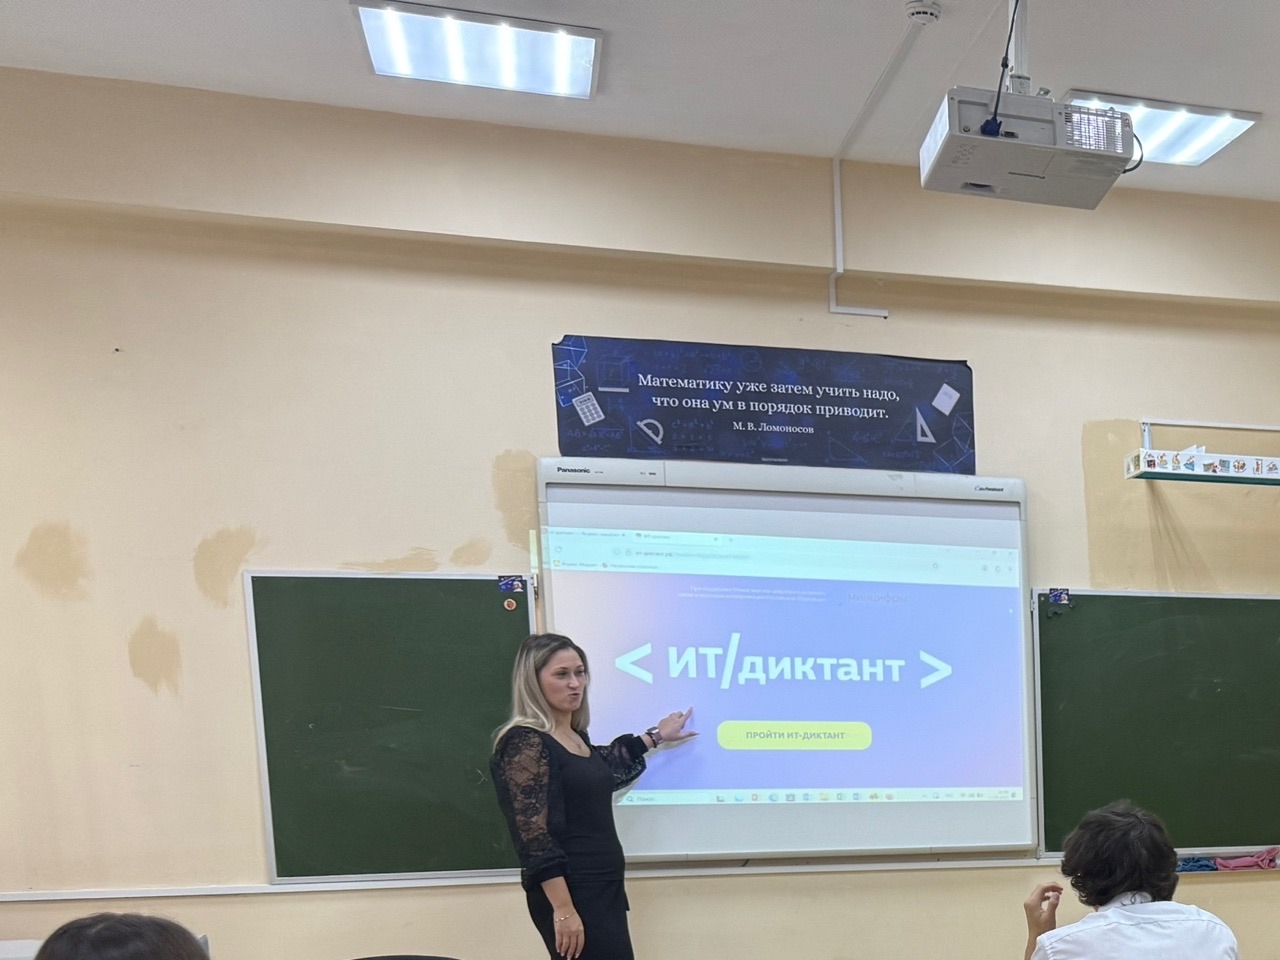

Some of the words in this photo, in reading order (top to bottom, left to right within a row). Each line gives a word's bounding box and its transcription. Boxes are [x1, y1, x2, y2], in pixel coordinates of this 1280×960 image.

[638, 373, 733, 394] Математику
[736, 381, 767, 394] уже
[770, 382, 813, 395] затем
[815, 385, 860, 399] учить
[863, 388, 900, 402] надо,
[652, 396, 679, 408] что
[682, 398, 710, 409] она
[712, 399, 734, 412] ум
[737, 400, 746, 411] в
[749, 400, 812, 415] порядок
[816, 404, 889, 419] приводит.
[732, 421, 745, 431] М.
[747, 422, 757, 431] В.
[759, 422, 815, 434] Ломоносов
[557, 466, 591, 474] Panasonic
[668, 632, 906, 690] ИТ/диктант
[745, 729, 785, 740] ПРОЙТИ
[787, 731, 846, 741] ИТ-ДИКТАНТ
